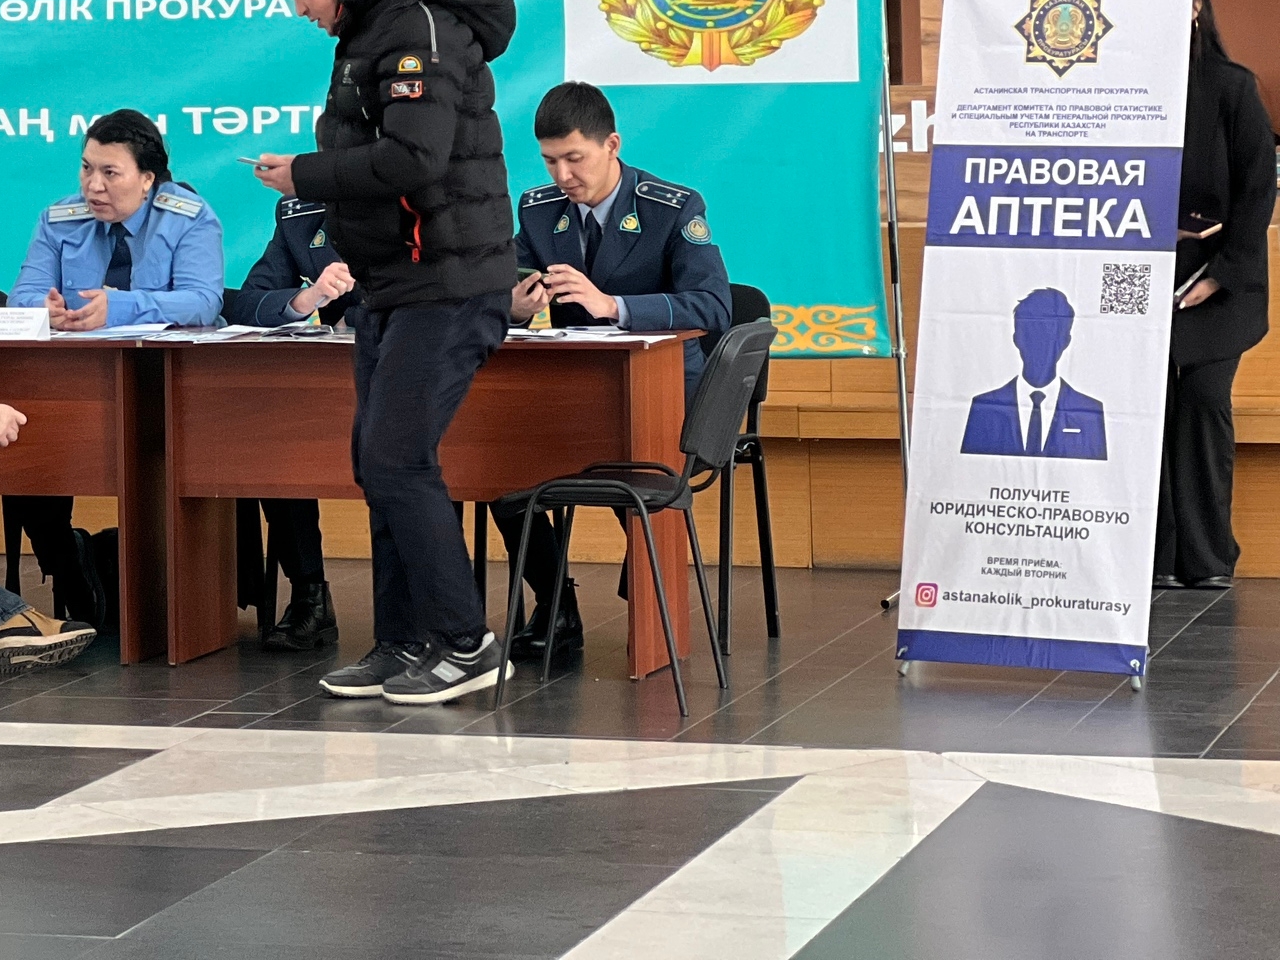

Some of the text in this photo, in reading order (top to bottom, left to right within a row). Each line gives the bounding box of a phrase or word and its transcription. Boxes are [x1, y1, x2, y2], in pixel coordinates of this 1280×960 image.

[1052, 112, 1108, 120] ГЕНЕРАЛЬНОЙ
[1111, 113, 1167, 121] ПРОКУРАТУРЫ
[1069, 104, 1112, 112] ПРАВОВОЙ
[964, 157, 1146, 186] ПРАВОВАЯ
[949, 195, 1152, 238] АПТЕКА
[989, 487, 1070, 503] ПОЛУЧИТЕ
[930, 501, 1130, 525] ЮРИДИЧЕСКО-ПРАВОВУЮ
[964, 521, 1090, 541] КОНСУЛЬТАЦИЮ
[987, 556, 1019, 566] ВРЕМЯ
[981, 566, 1067, 579] КАЖДЫЙ ВТОРНИК
[942, 590, 1132, 615] astanakolik_prokuraturasy
